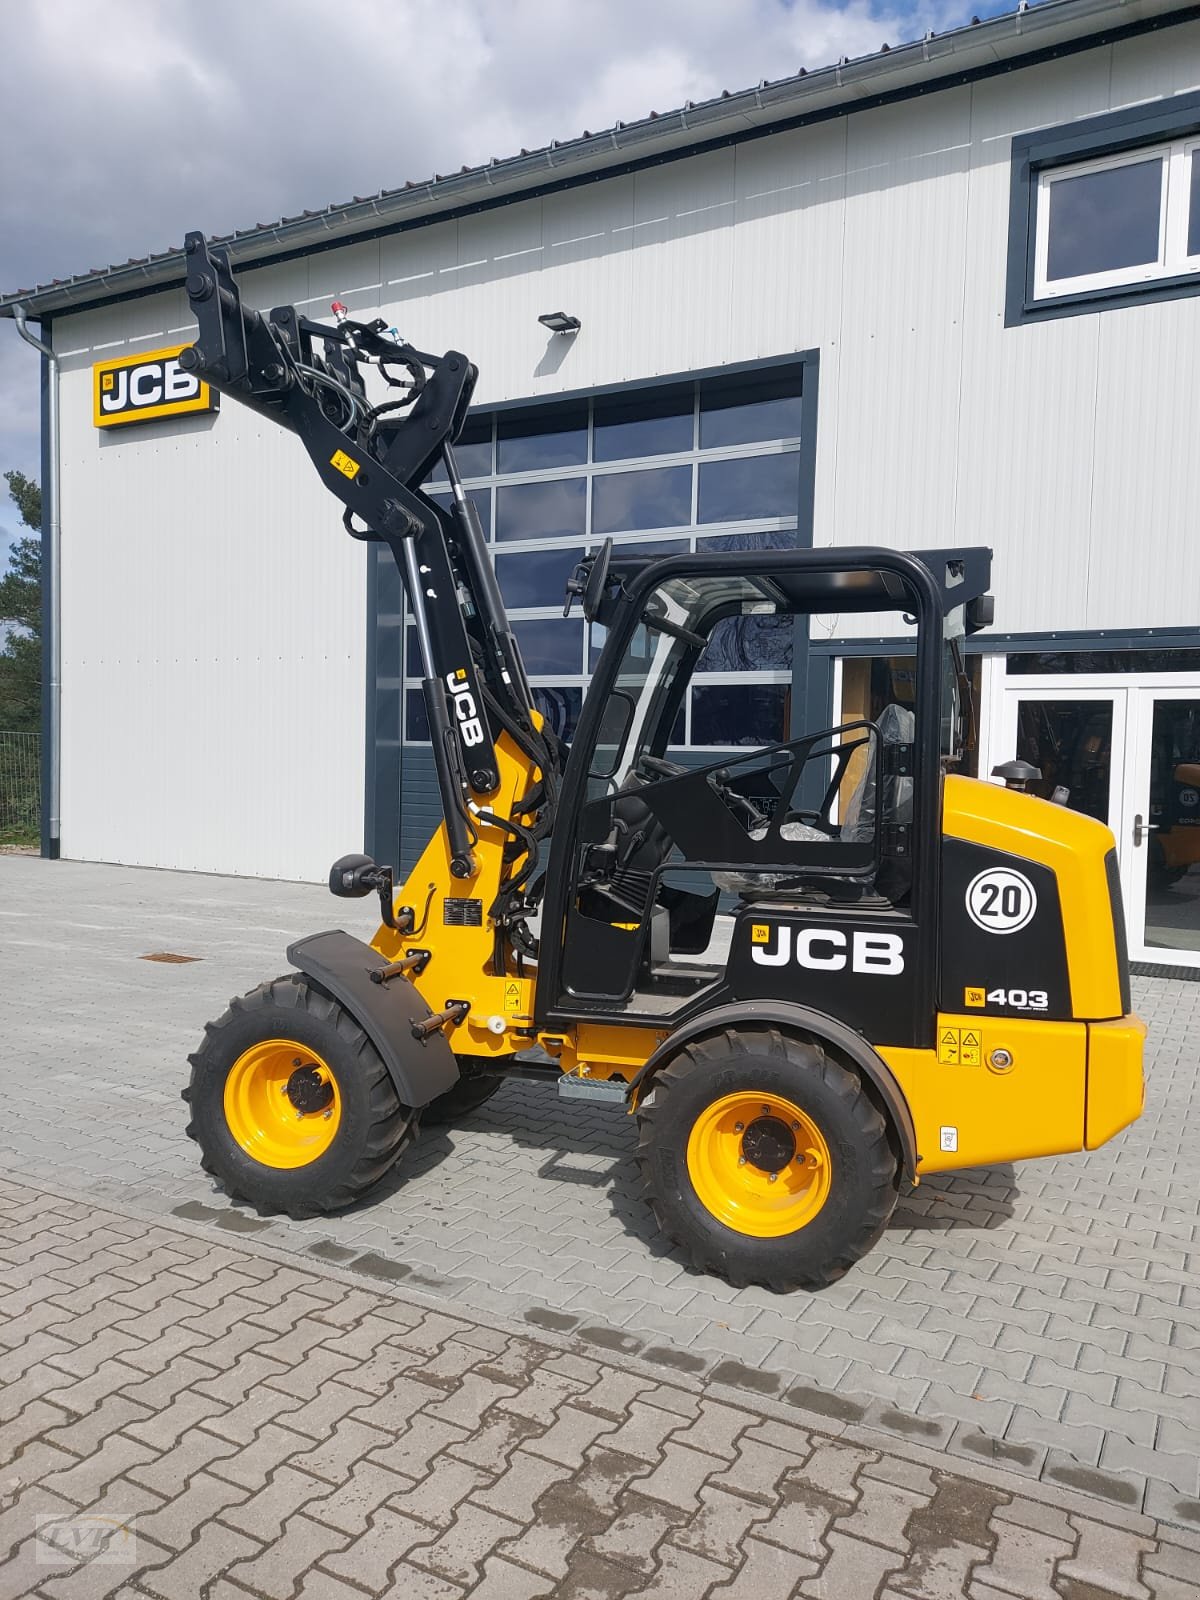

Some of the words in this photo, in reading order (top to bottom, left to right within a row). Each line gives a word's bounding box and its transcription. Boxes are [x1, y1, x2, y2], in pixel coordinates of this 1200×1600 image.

[102, 360, 199, 411] JCB
[446, 670, 484, 747] JCB
[979, 883, 1022, 918] 20
[751, 926, 905, 976] JCB
[987, 989, 1049, 1008] 403
